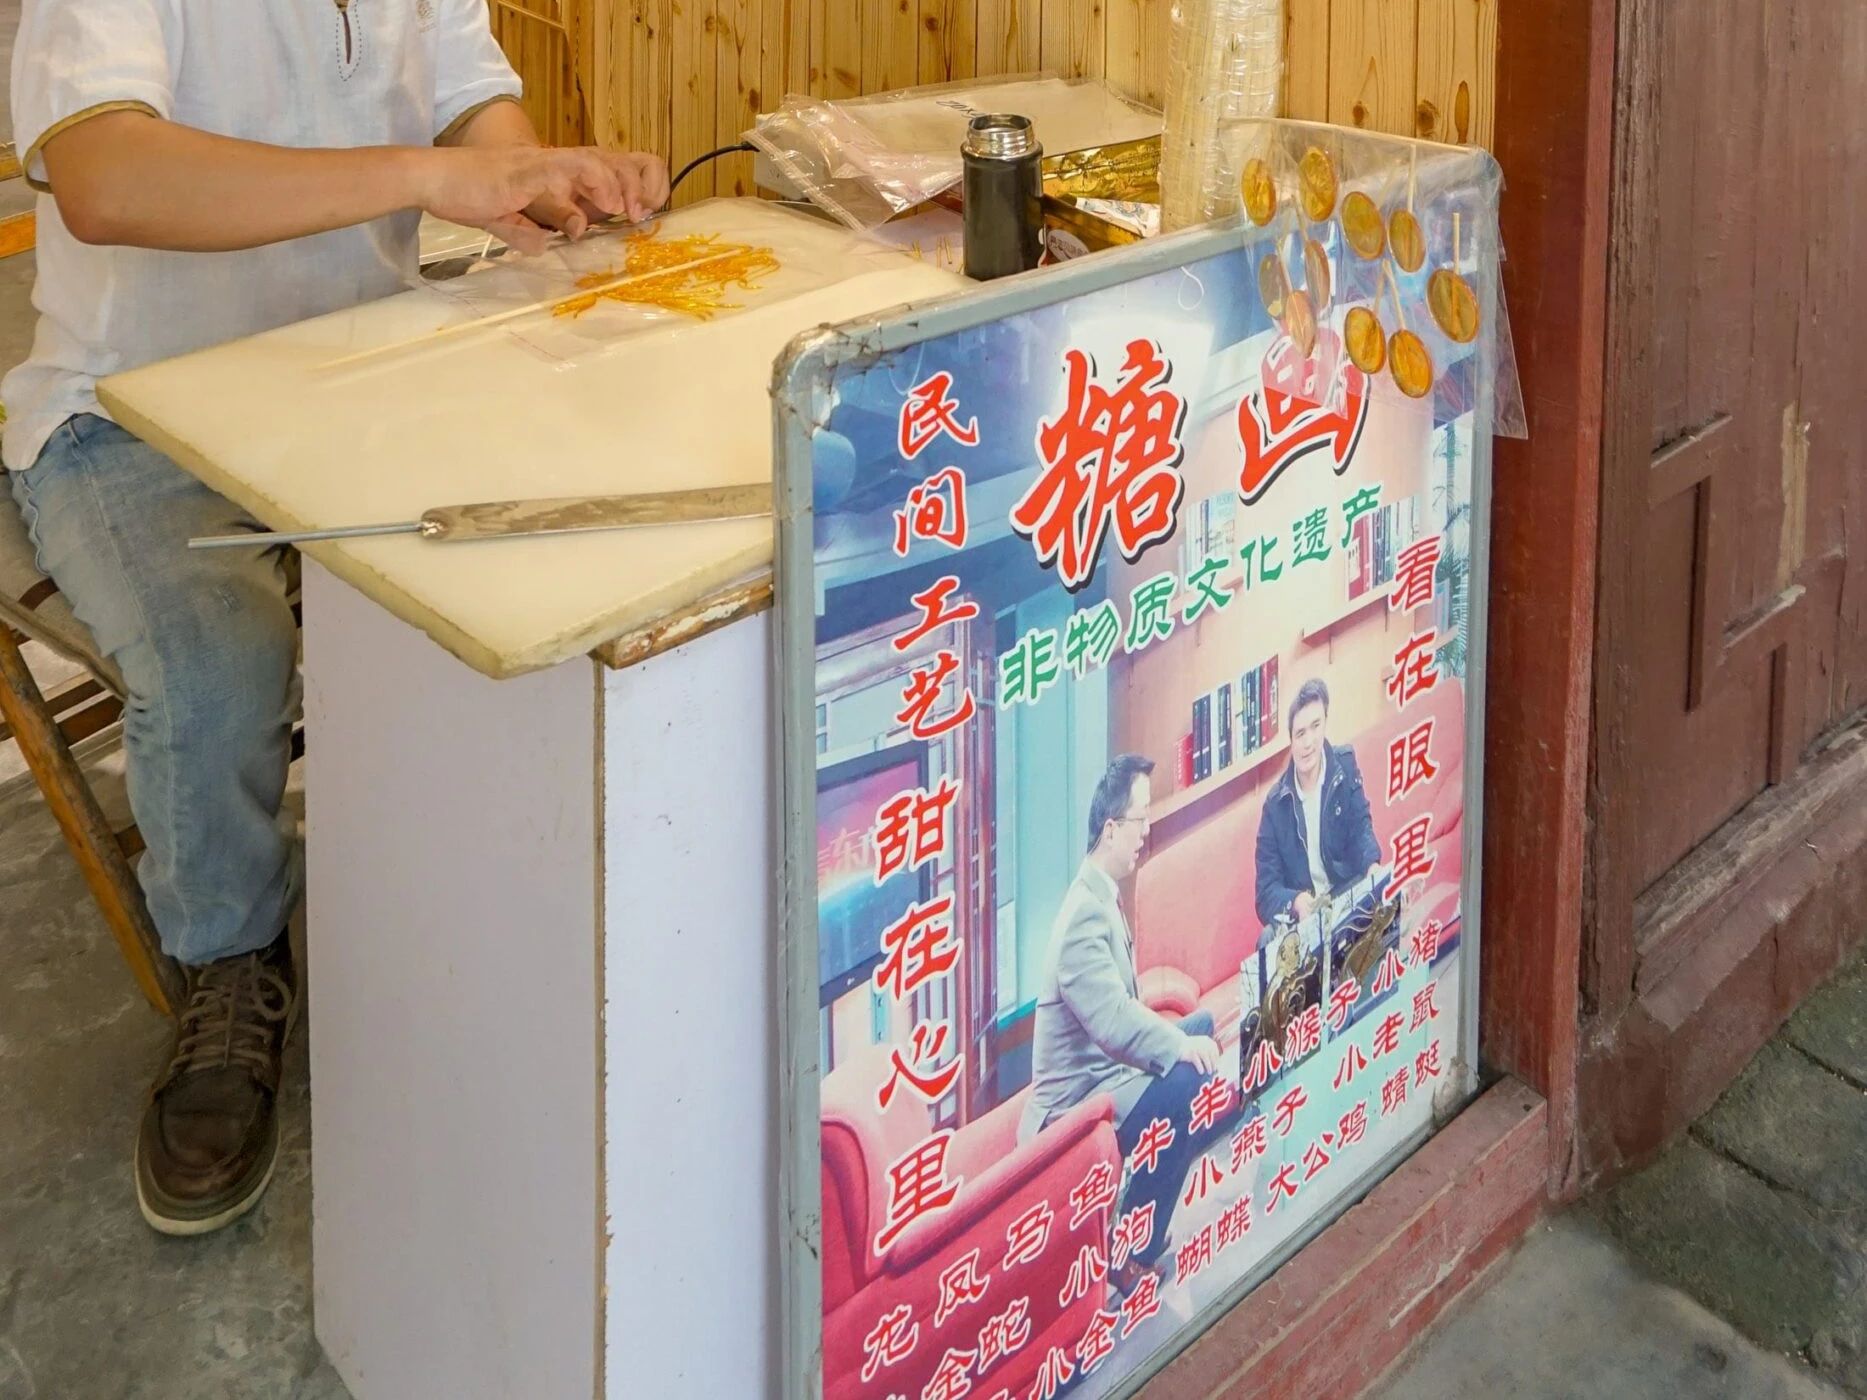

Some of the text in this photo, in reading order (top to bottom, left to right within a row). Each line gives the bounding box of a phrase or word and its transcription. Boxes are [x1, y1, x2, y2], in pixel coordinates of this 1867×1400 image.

[1003, 483, 1383, 706] 非物质文化遗产
[1384, 535, 1441, 903] 看在眼里
